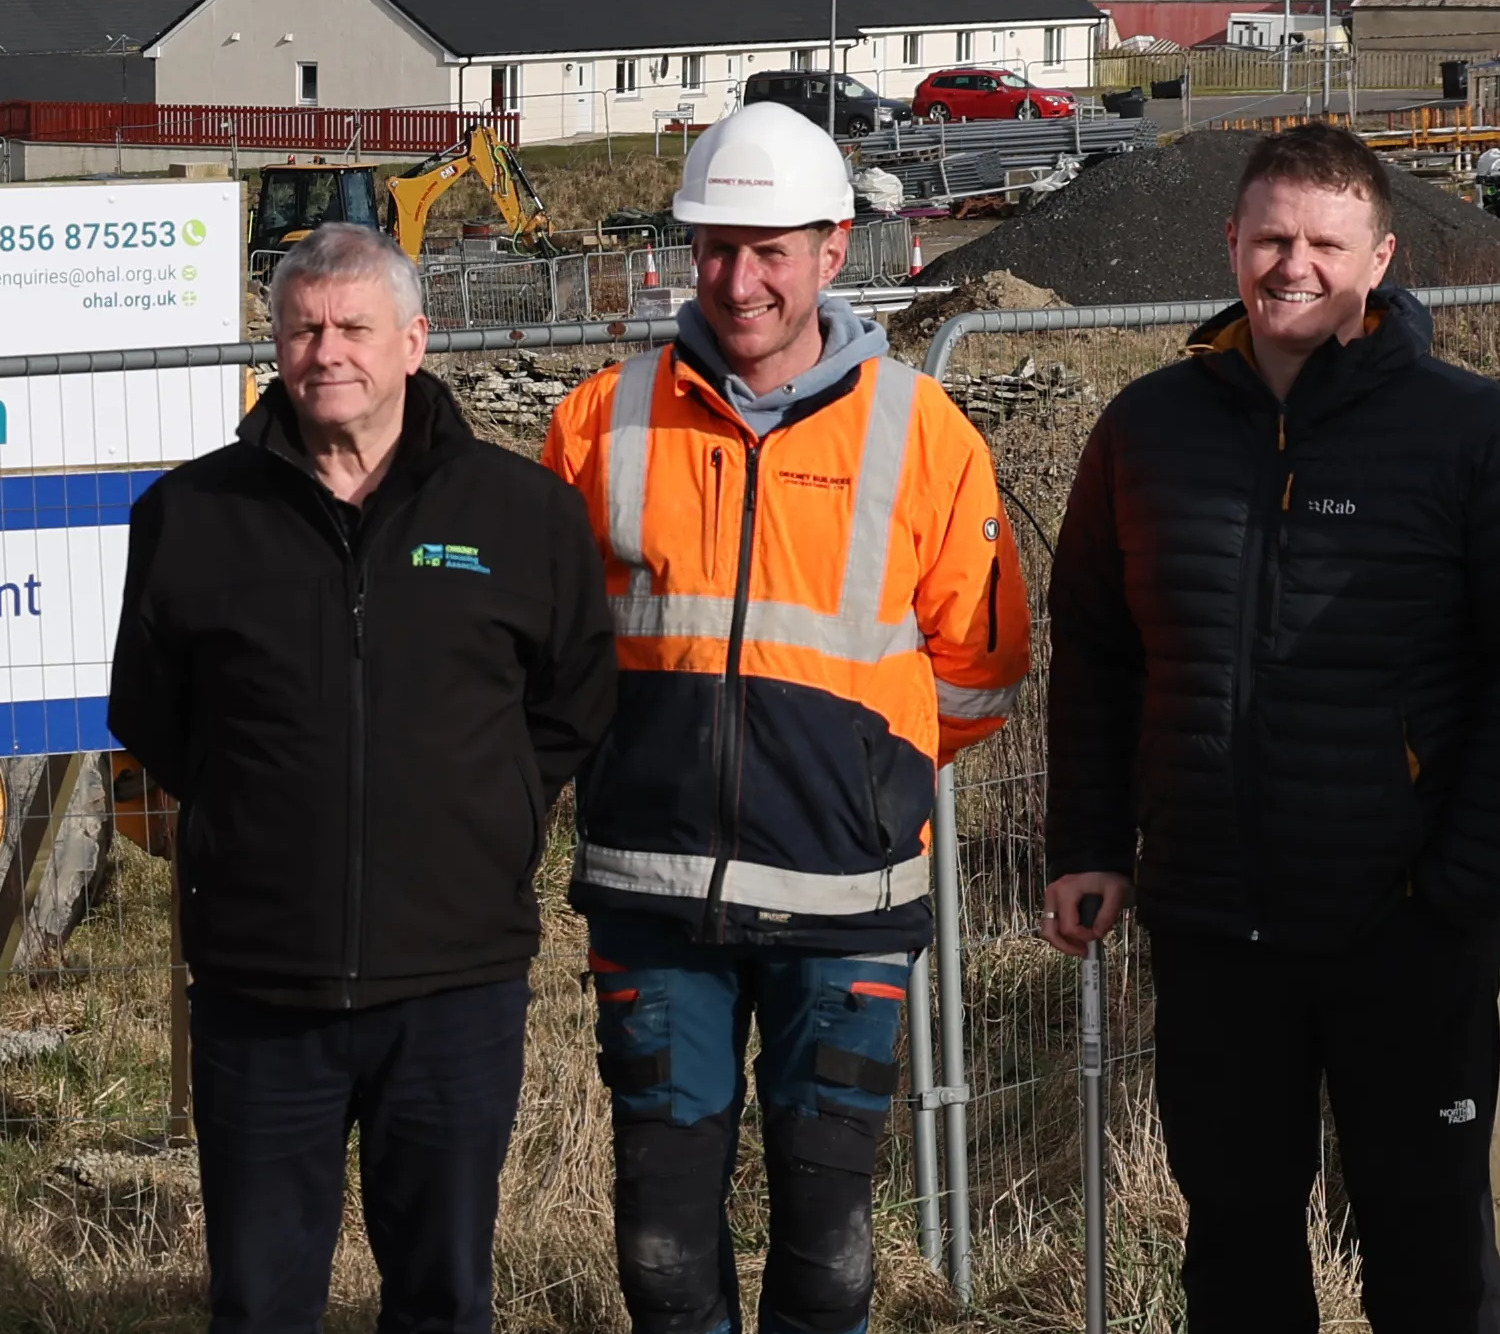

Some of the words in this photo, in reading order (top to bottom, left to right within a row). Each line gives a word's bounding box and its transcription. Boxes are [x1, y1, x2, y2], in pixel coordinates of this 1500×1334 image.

[440, 165, 456, 179] CAT
[738, 178, 774, 186] BUILDERS
[64, 220, 176, 250] 875253
[82, 290, 177, 310] ohal.org.uk
[1322, 498, 1356, 515] Rab
